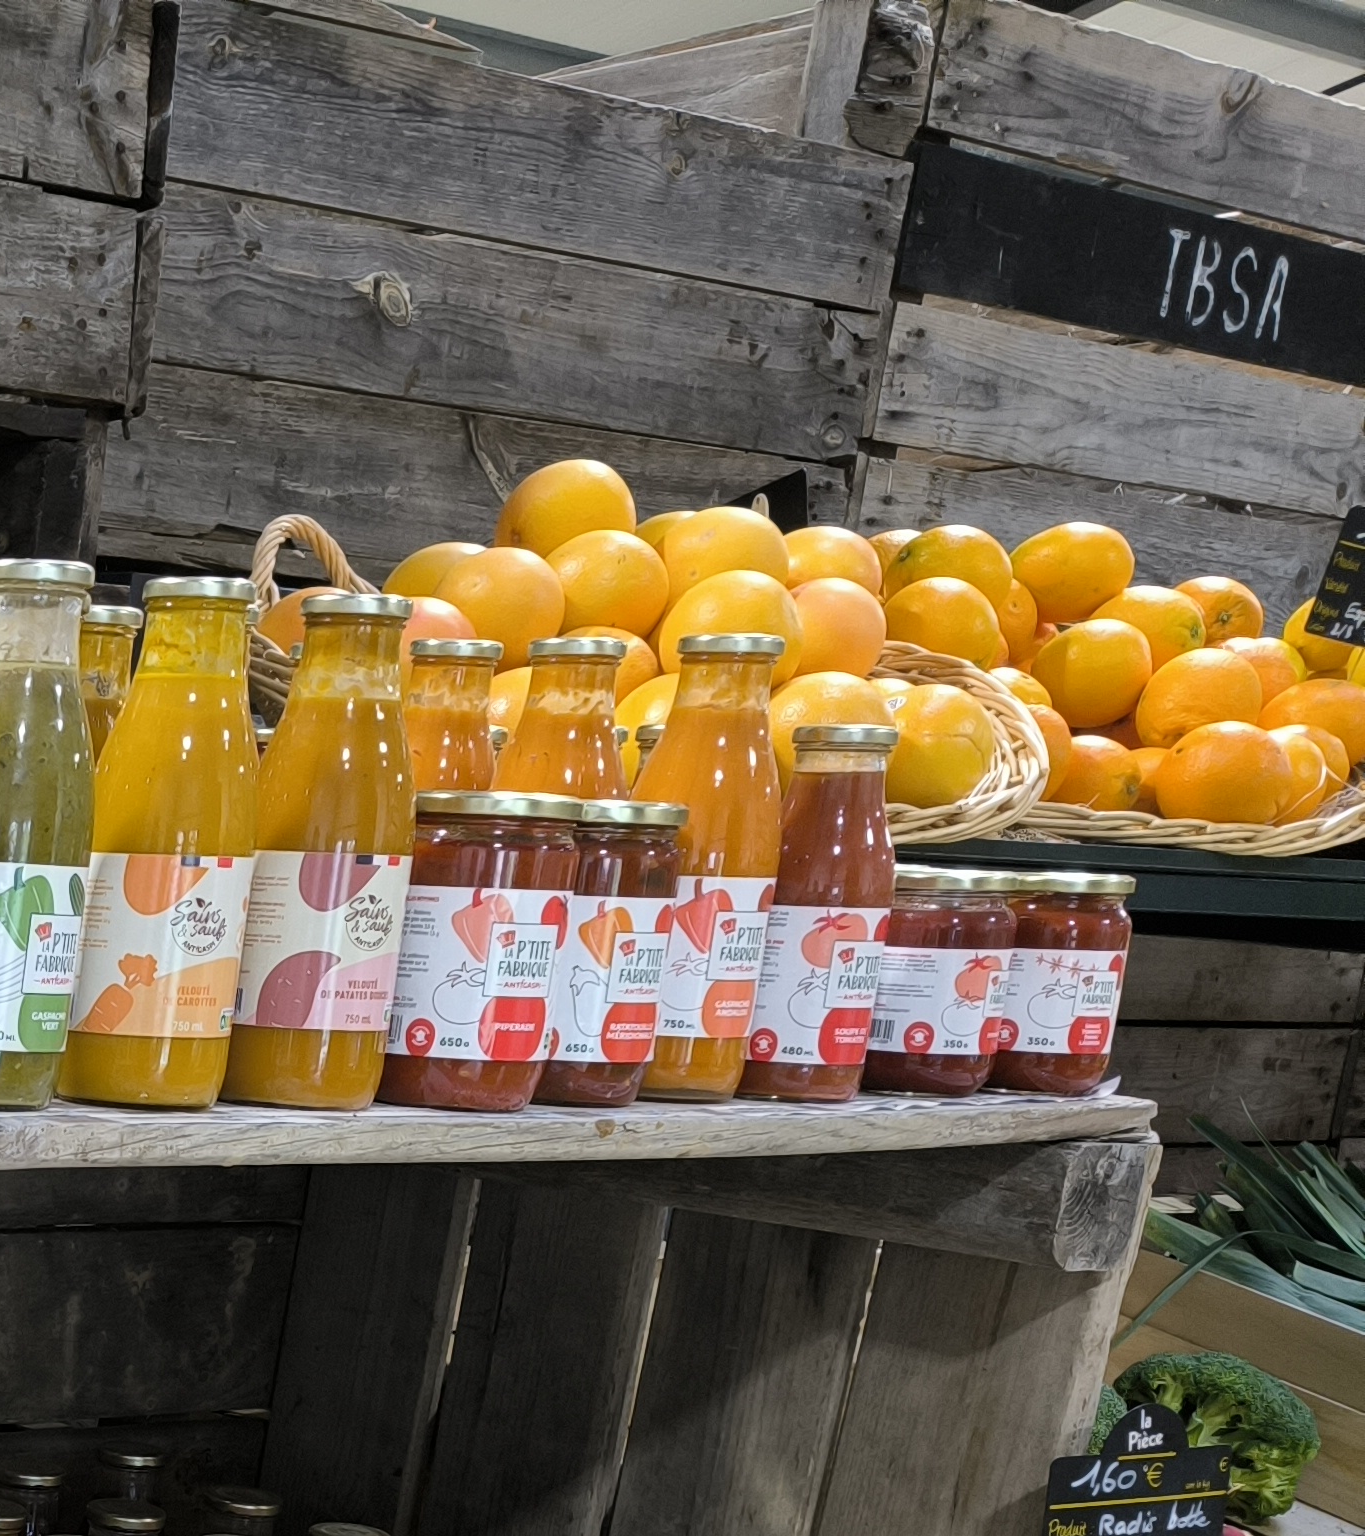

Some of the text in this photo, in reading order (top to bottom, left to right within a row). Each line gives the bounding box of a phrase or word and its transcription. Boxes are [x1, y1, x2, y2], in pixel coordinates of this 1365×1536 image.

[1159, 228, 1289, 343] TBSA
[498, 960, 550, 980] FABRIQUE
[1140, 1409, 1152, 1428] la
[1128, 1432, 1163, 1452] Pièce
